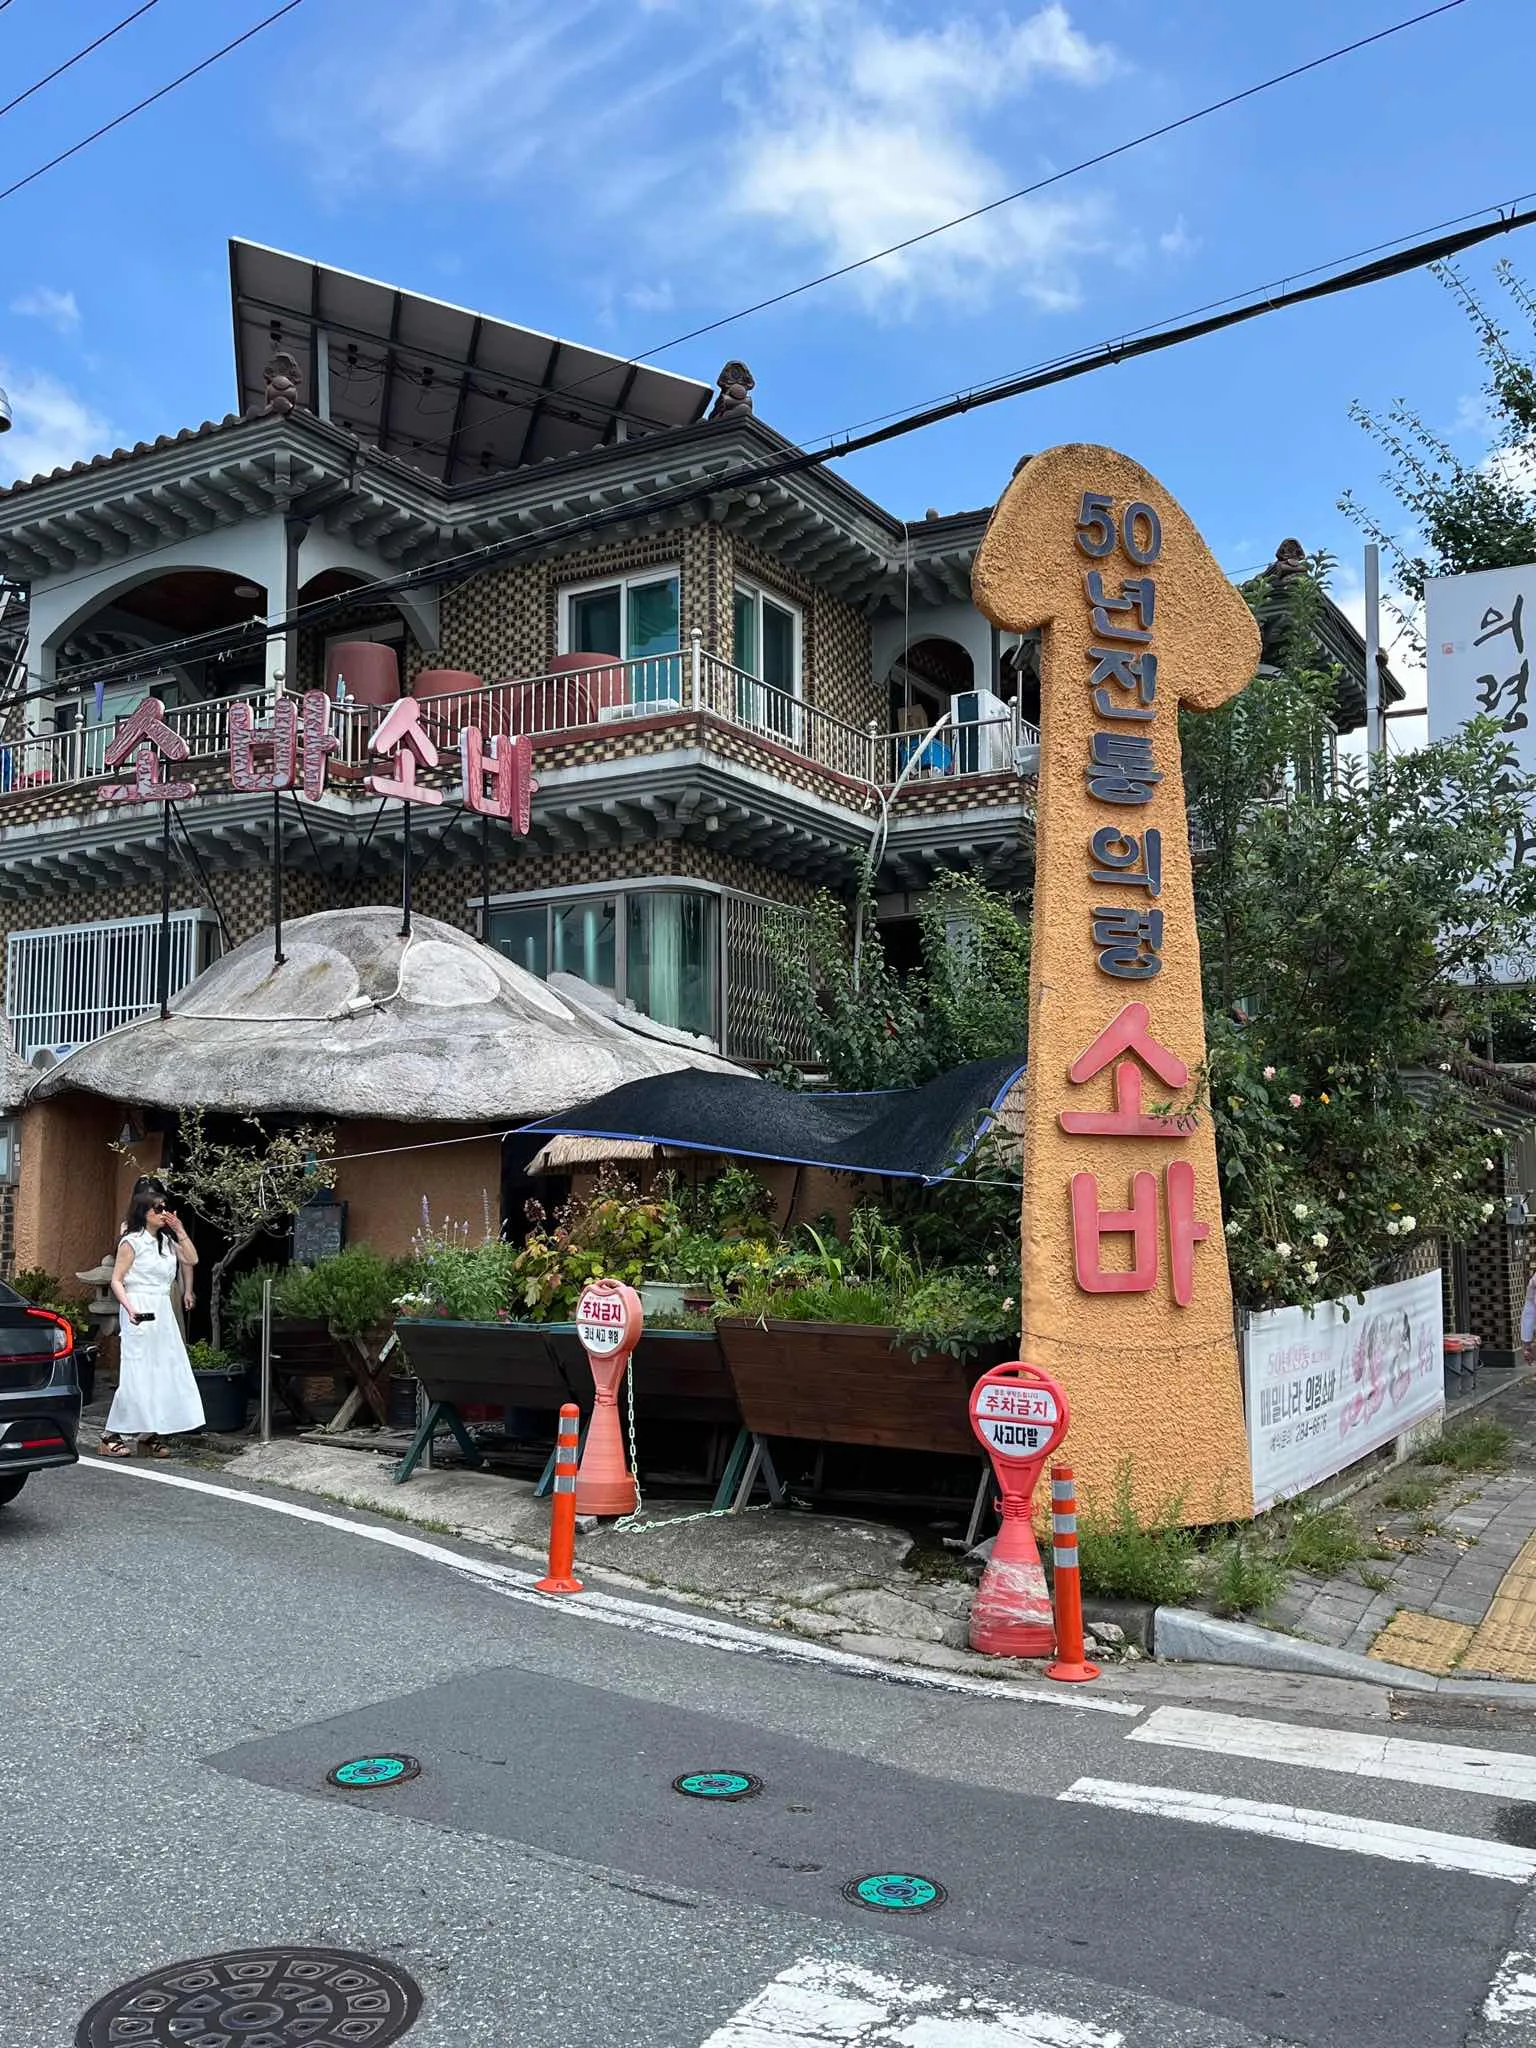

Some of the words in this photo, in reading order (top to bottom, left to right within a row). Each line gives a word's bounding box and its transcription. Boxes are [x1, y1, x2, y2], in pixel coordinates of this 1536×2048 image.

[98, 689, 340, 801] 소바
[364, 696, 539, 836] 소바
[1088, 826, 1164, 980] 의령
[1056, 1001, 1210, 1307] 소바
[583, 1301, 621, 1322] 주차금지
[584, 1327, 594, 1341] 코너
[596, 1328, 606, 1342] 사고
[608, 1329, 619, 1344] 위험
[985, 1396, 1048, 1418] 주차금지
[1260, 1379, 1303, 1428] 메밀나라
[993, 1424, 1039, 1448] 사고다발
